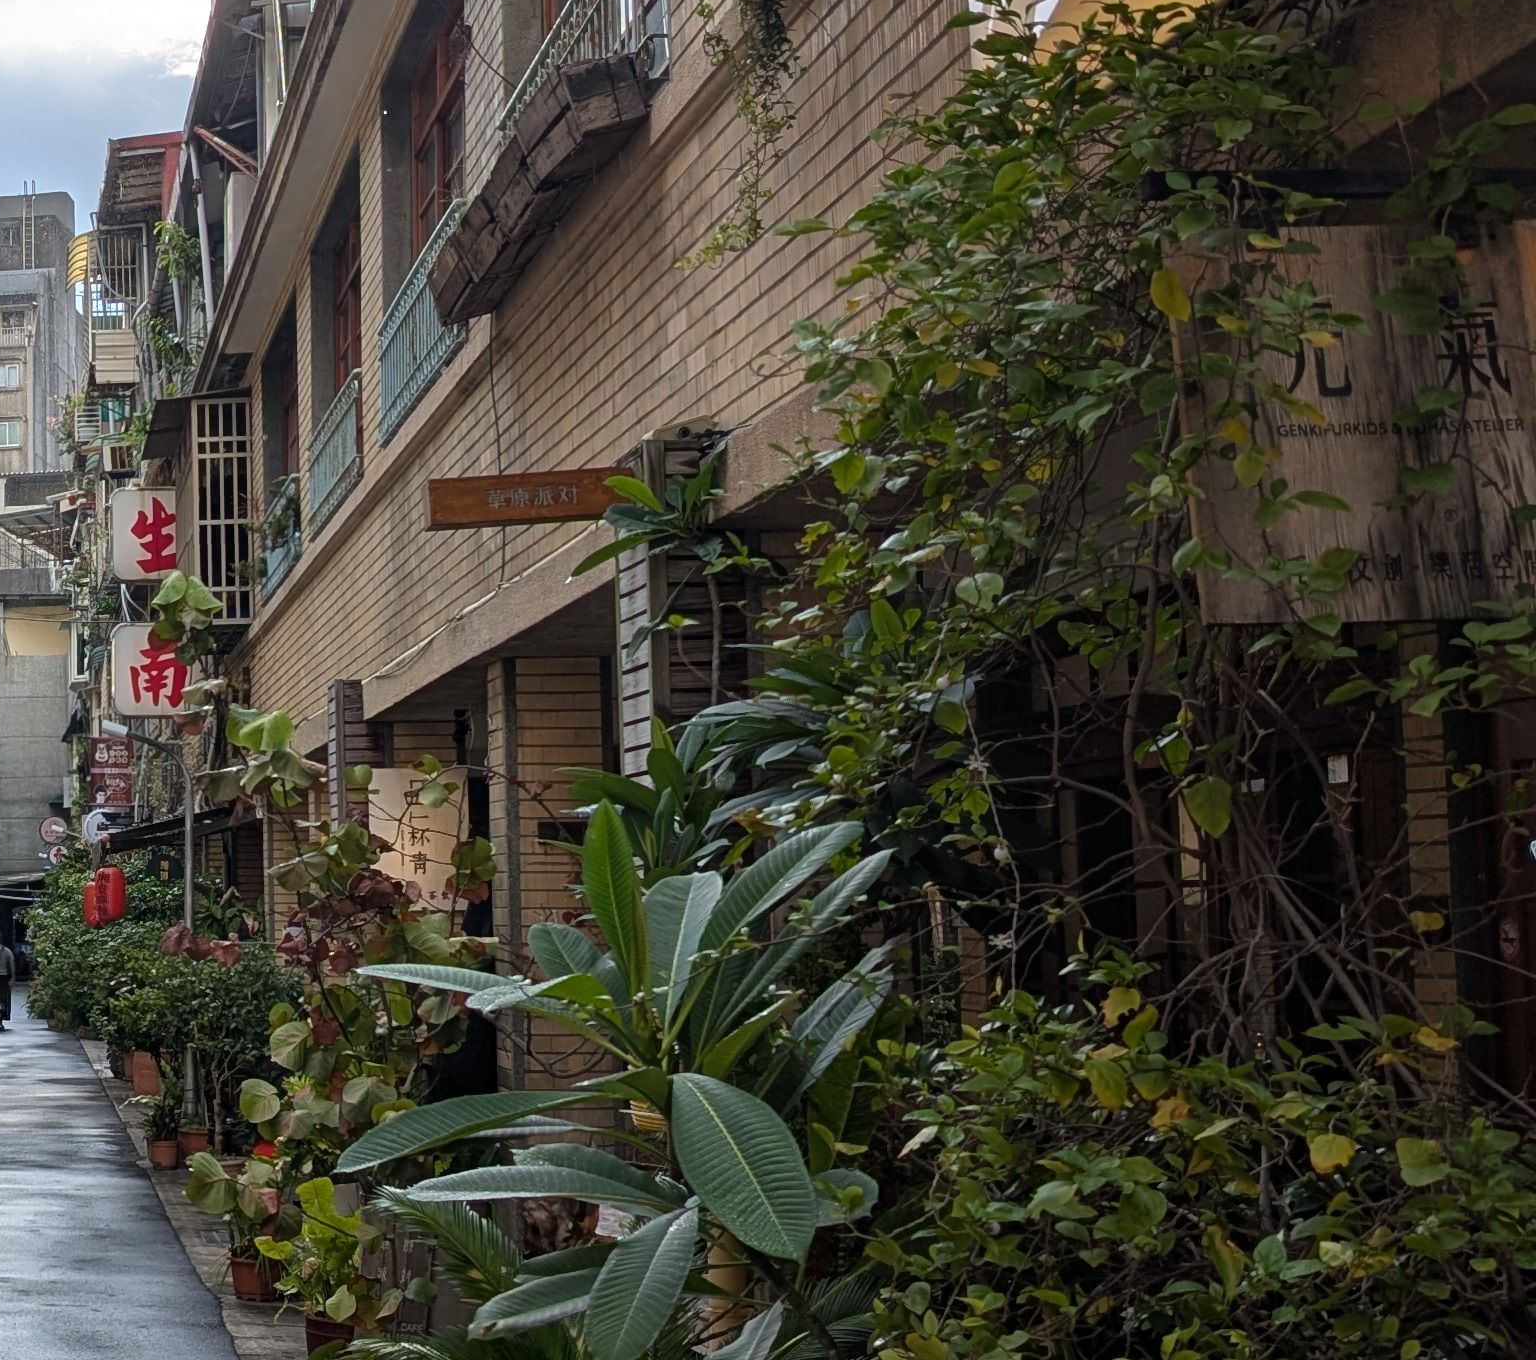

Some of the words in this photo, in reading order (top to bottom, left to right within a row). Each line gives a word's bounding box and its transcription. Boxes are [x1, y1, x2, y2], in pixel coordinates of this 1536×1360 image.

[1465, 416, 1525, 433] ATELIER
[130, 496, 177, 574] 生
[129, 642, 188, 709] 南
